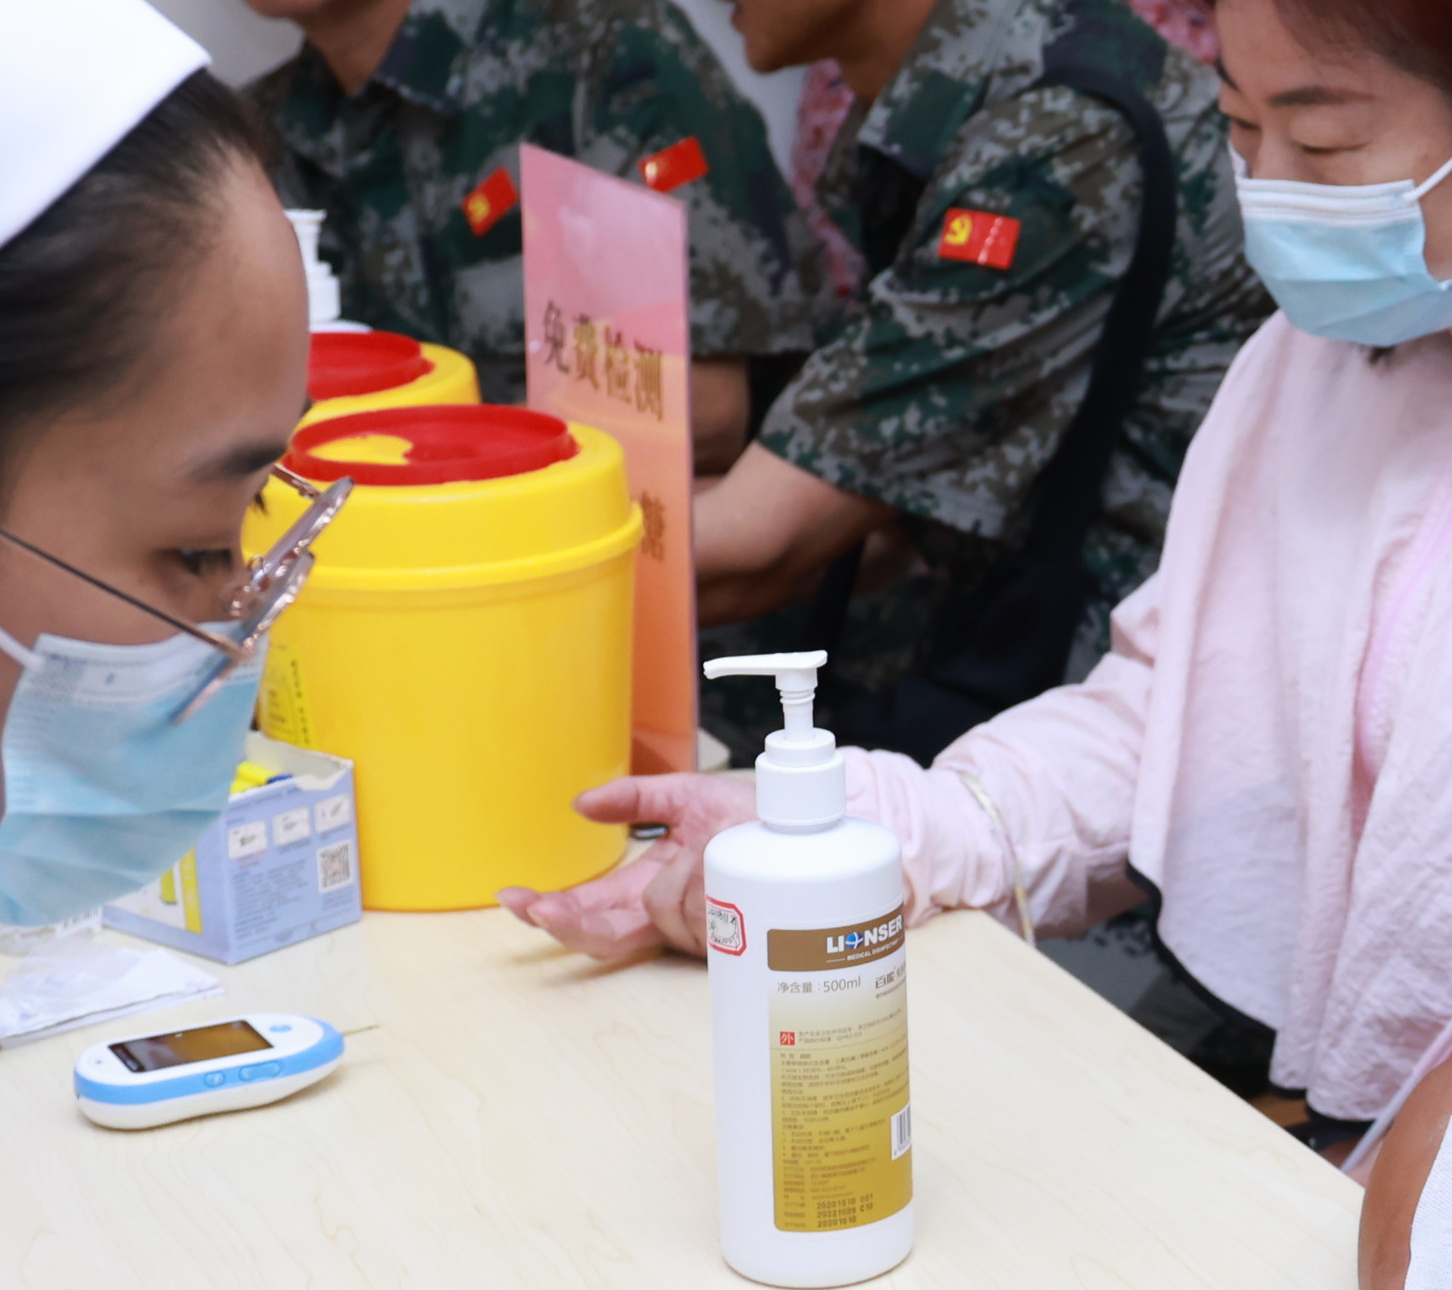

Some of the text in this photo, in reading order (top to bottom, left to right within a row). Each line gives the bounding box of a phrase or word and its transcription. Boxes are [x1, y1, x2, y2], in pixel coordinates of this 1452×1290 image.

[542, 300, 665, 422] 免费检测
[826, 913, 902, 954] LIONSER
[780, 1031, 795, 1045] 外
